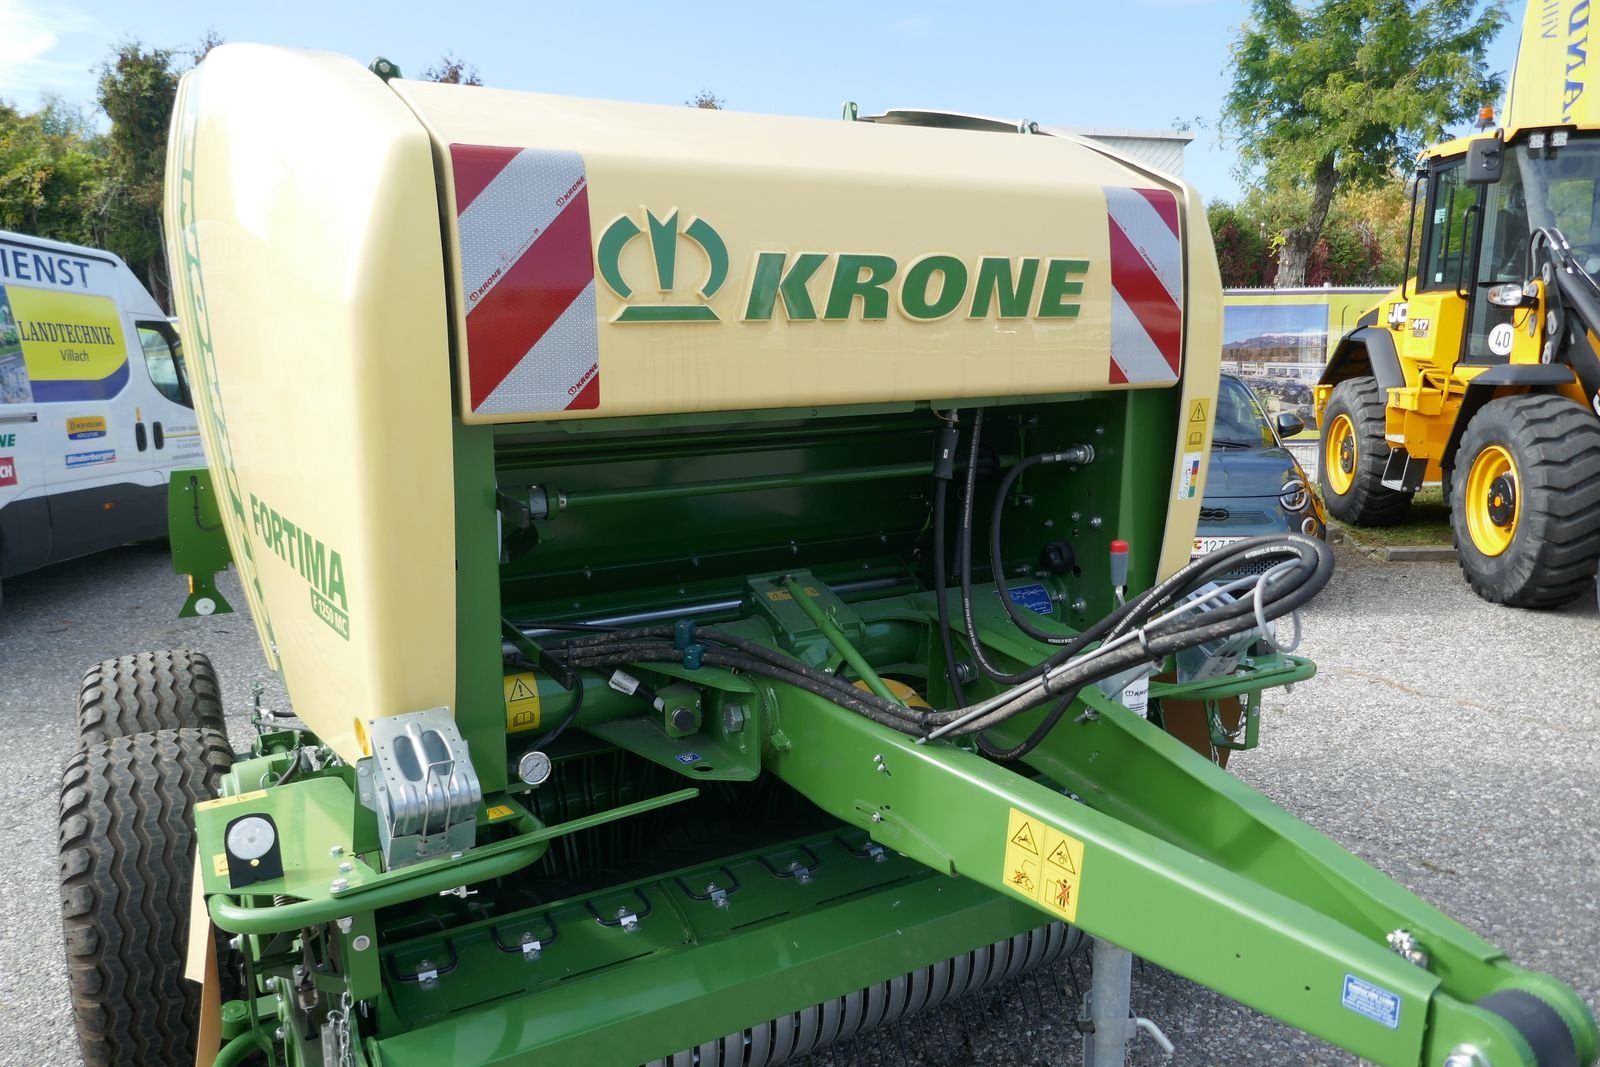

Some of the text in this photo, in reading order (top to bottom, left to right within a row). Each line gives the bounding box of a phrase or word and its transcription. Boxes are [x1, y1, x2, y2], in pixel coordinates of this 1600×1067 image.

[564, 175, 586, 201] KRONE
[0, 248, 90, 289] IENST
[478, 268, 502, 296] KRONE
[742, 251, 1091, 322] KRONE
[17, 320, 115, 345] LANDTECHNIK
[1412, 319, 1429, 331] 417
[1495, 331, 1511, 349] 40
[60, 349, 90, 362] Villach
[576, 362, 599, 389] KRONE
[250, 492, 349, 614] FORTIMA
